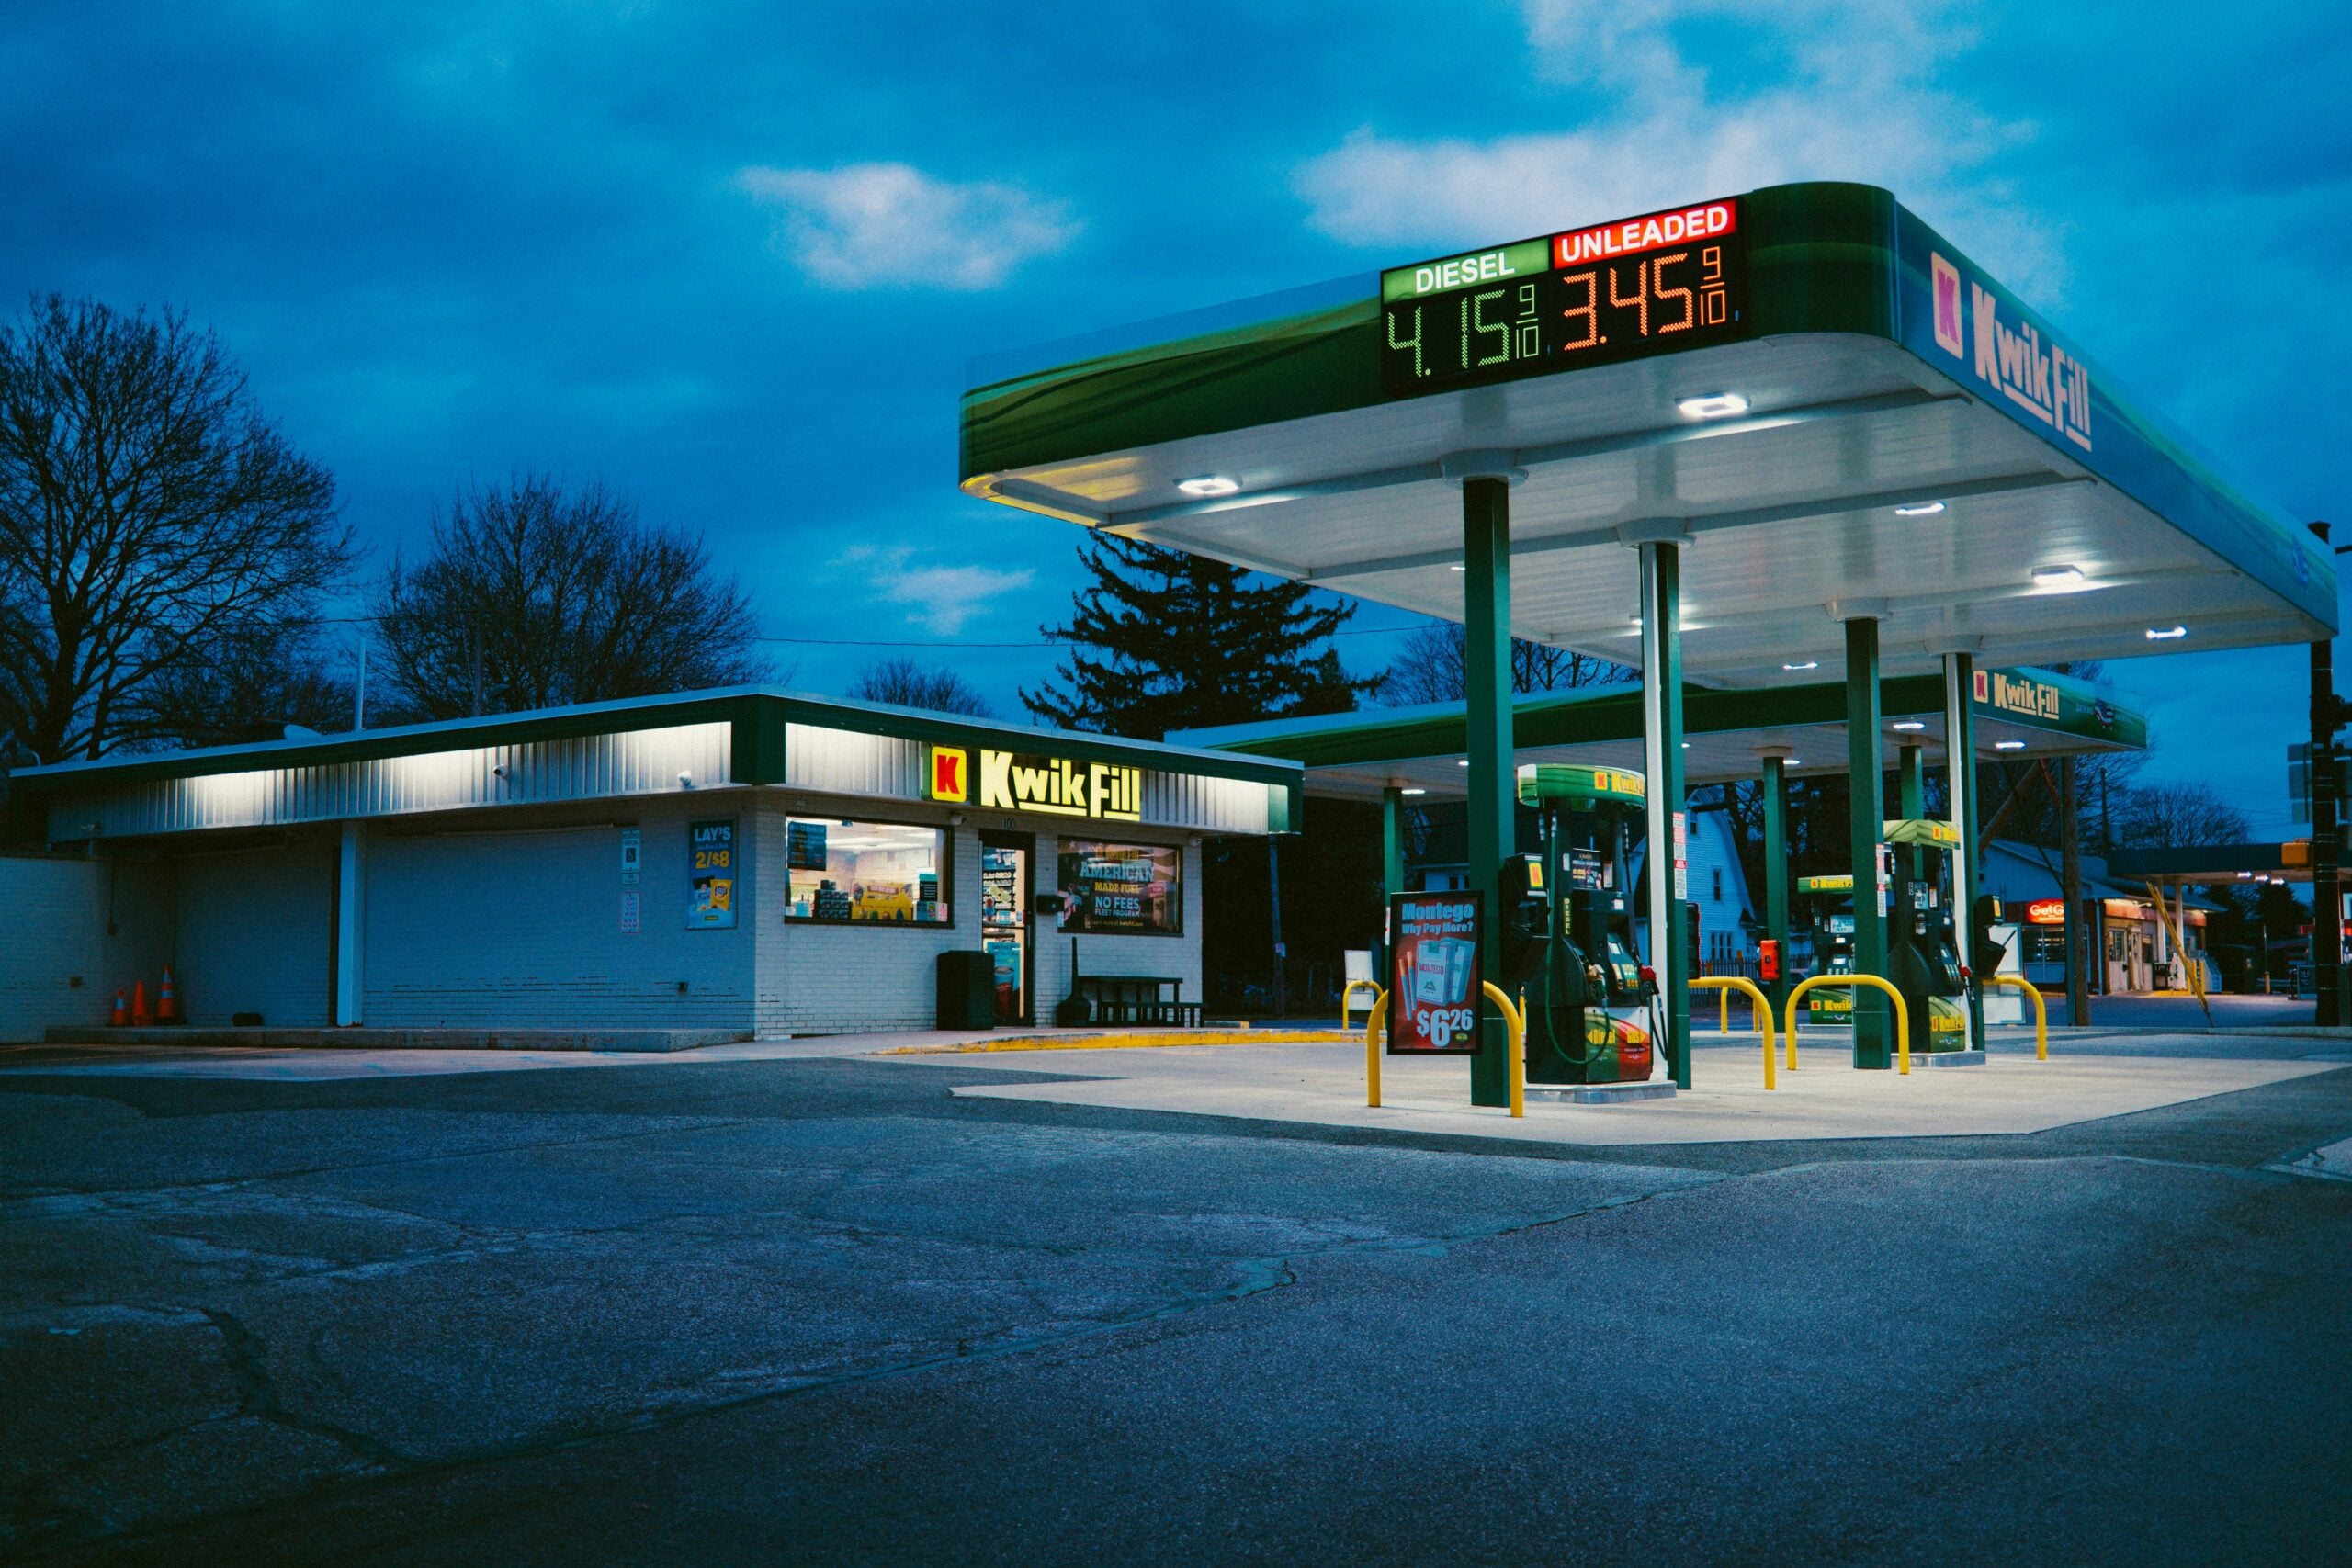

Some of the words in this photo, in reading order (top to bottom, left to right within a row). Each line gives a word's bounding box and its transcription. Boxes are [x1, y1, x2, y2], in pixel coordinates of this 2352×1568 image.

[1562, 205, 1728, 262] UNLEADED
[1416, 252, 1515, 294] DIESEL
[936, 754, 960, 795] K
[695, 826, 731, 842] LAY'S
[695, 850, 730, 869] 2/$8
[1080, 861, 1154, 882] AMERICAN
[1094, 882, 1118, 893] MADE
[1120, 884, 1139, 894] FUEL
[1094, 896, 1111, 908] NO
[1114, 897, 1139, 910] FEES
[2030, 904, 2064, 916] GetG
[1113, 909, 1140, 918] PROGRAM
[1402, 903, 1474, 923] Montego
[1402, 923, 1421, 935] Why
[1423, 922, 1442, 935] Pay
[1442, 921, 1474, 933] More?
[1419, 963, 1444, 976] MONTEGO
